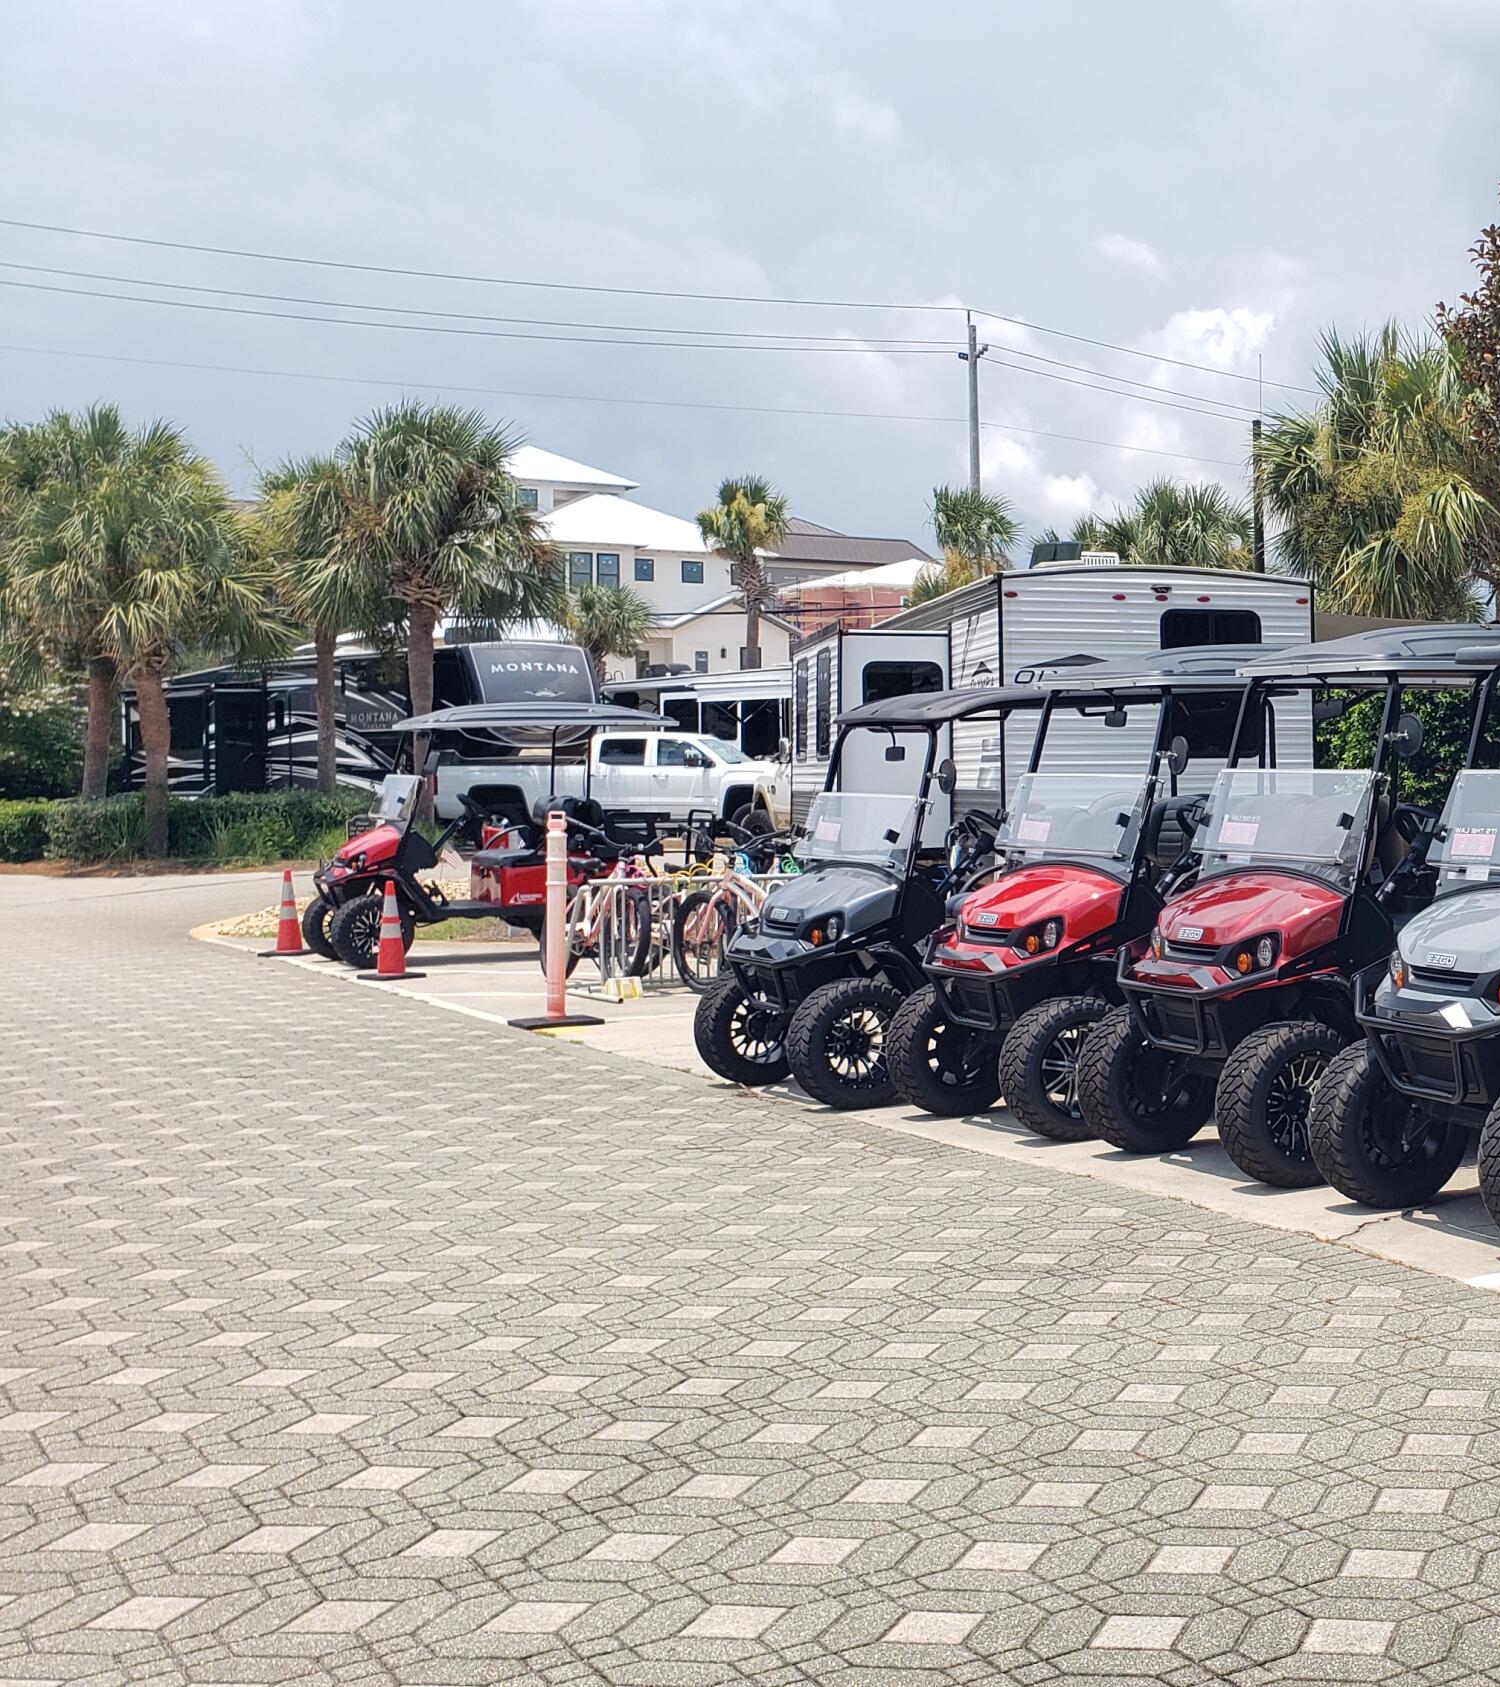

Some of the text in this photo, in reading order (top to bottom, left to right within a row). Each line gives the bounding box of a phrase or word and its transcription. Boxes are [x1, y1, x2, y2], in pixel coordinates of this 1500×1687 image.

[491, 662, 579, 674] MONTANA
[350, 711, 399, 722] MONTANA
[1427, 954, 1454, 965] EZGO
